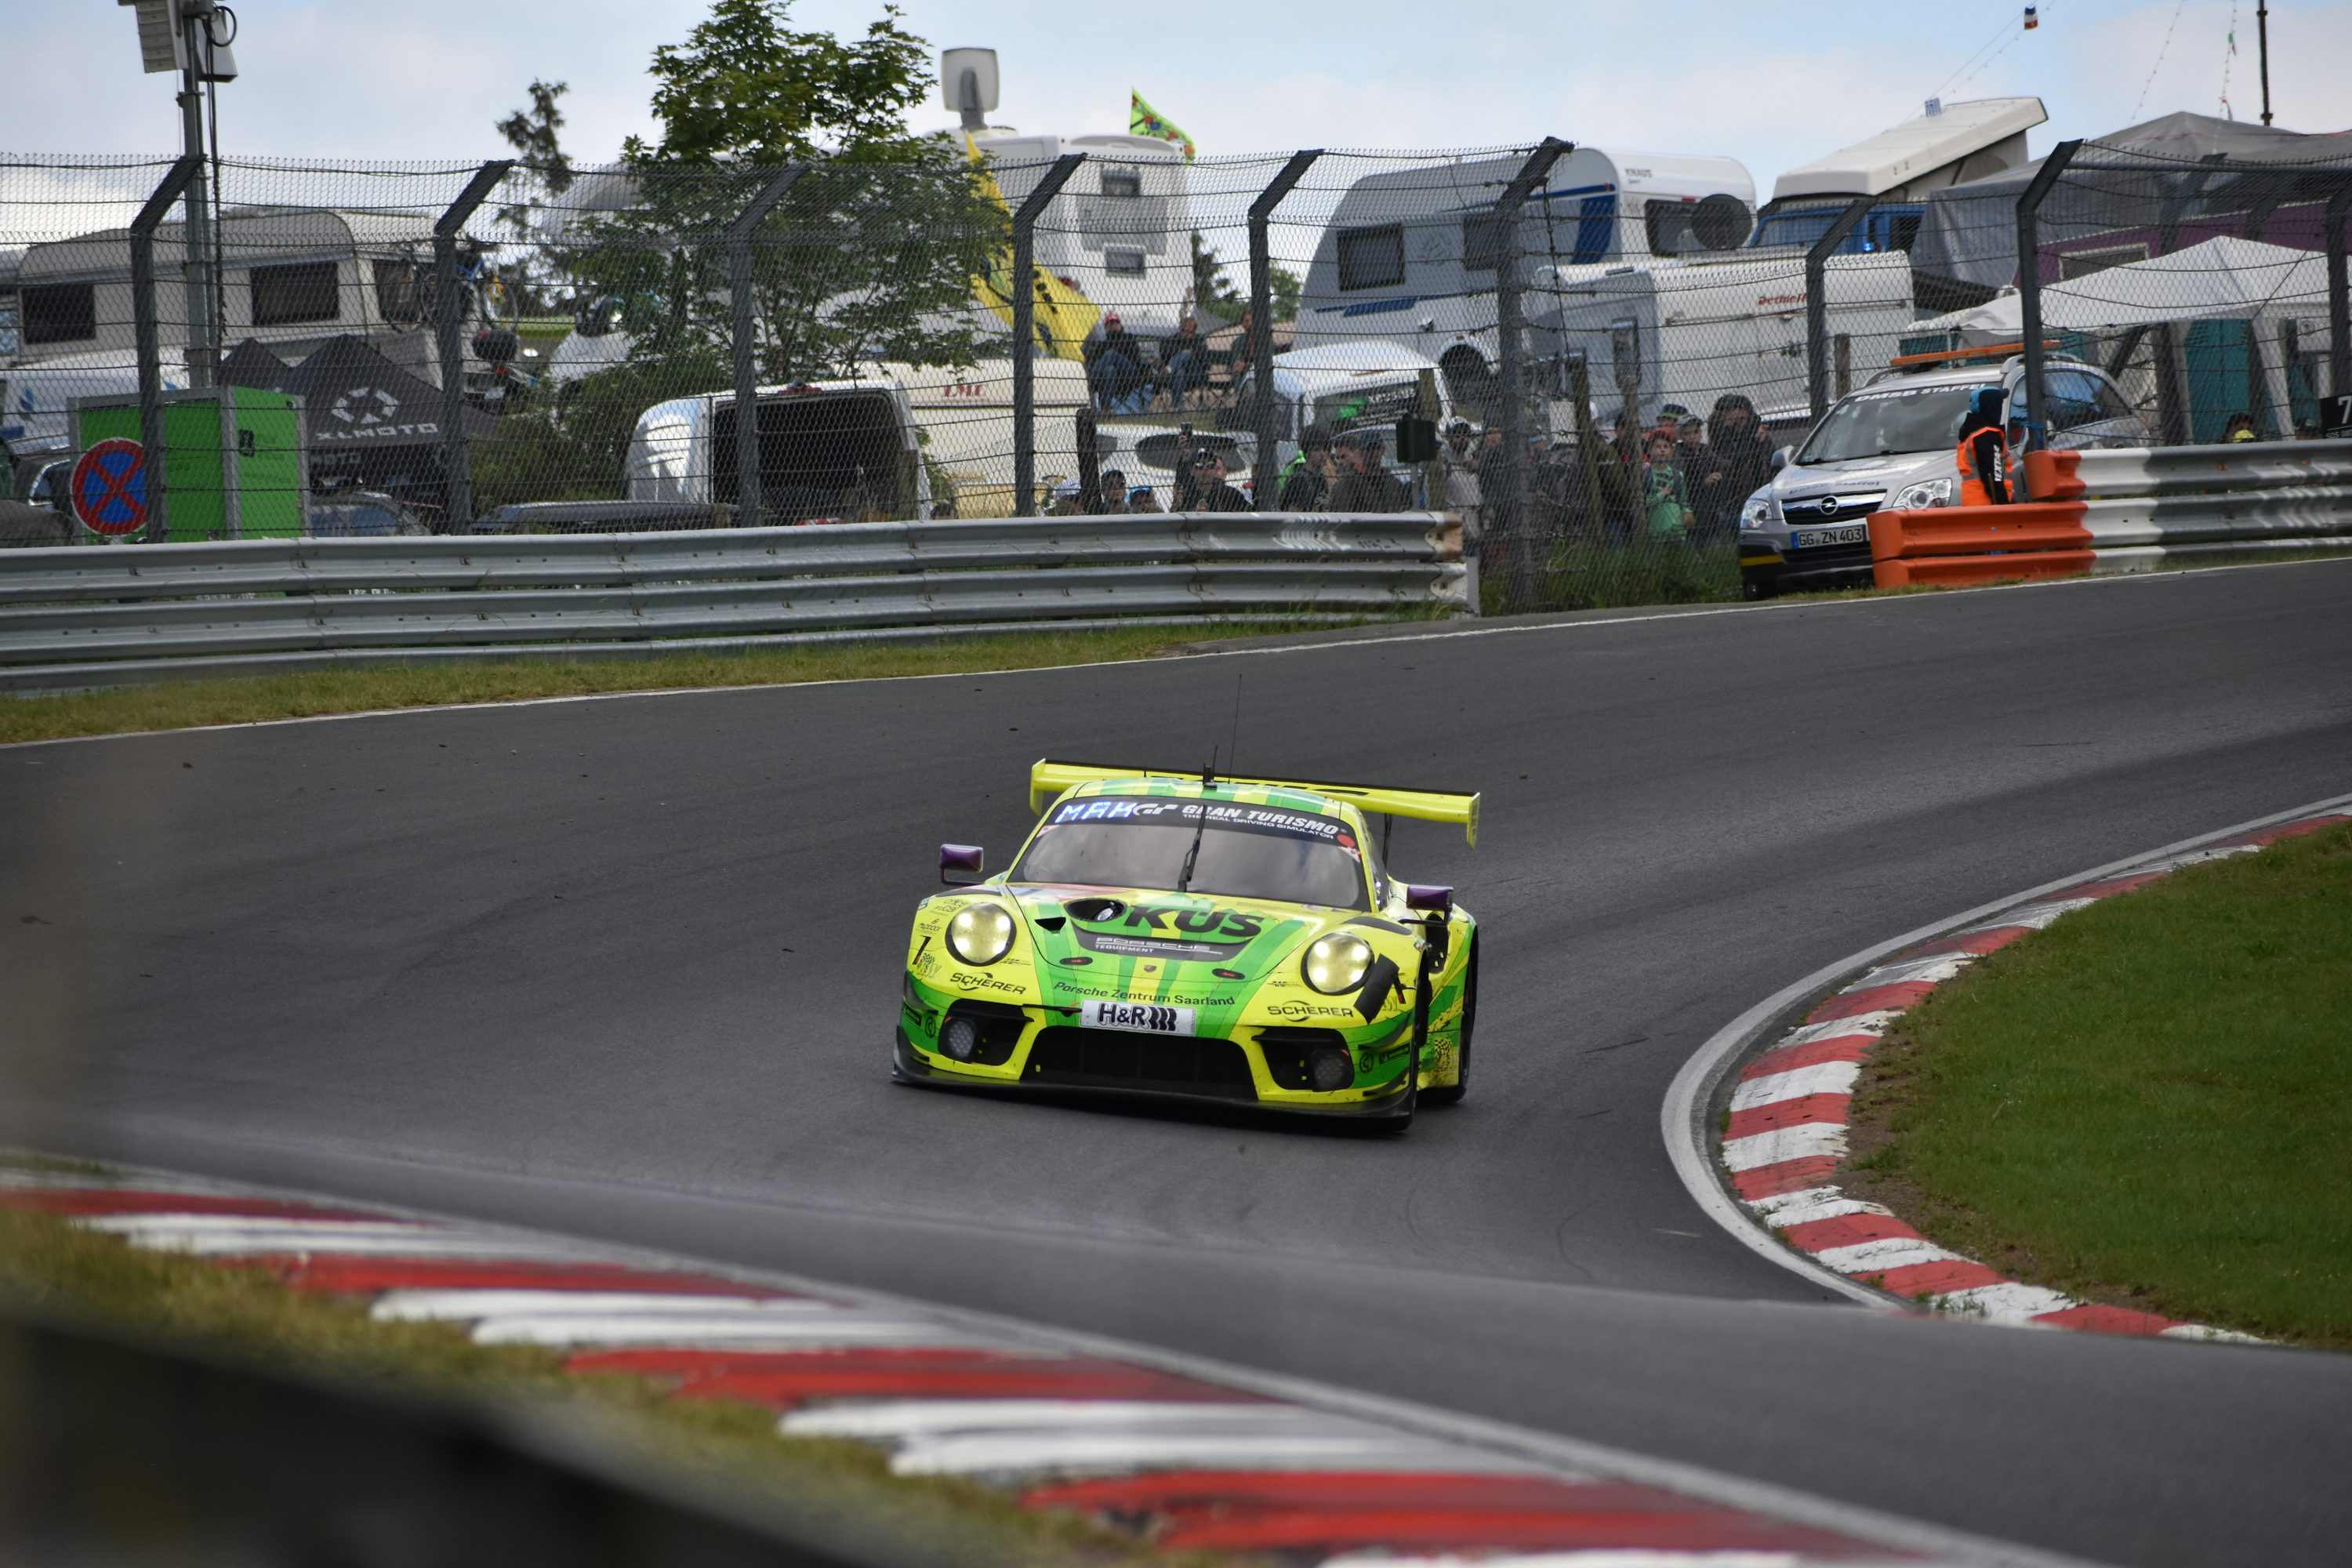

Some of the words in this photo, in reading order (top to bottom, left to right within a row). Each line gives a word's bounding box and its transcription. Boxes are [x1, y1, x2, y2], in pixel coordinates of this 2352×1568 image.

[315, 423, 439, 441] XLMOTO
[1798, 533, 1814, 546] GG
[1821, 531, 1838, 544] ZN
[1839, 528, 1862, 542] 403
[1182, 804, 1243, 818] GRAN
[1244, 811, 1339, 835] TURISMO
[1233, 818, 1275, 827] DRIVING
[1276, 823, 1334, 840] SIMULATOR
[1095, 937, 1210, 952] PORSCHE
[1095, 944, 1154, 953] TEQUIPMENT
[949, 971, 1027, 995] SCHERER
[1054, 982, 1109, 997] Porsche
[1111, 989, 1171, 1003] Zentrum
[1174, 995, 1236, 1006] Saarland
[1267, 1005, 1354, 1018] SCHERER
